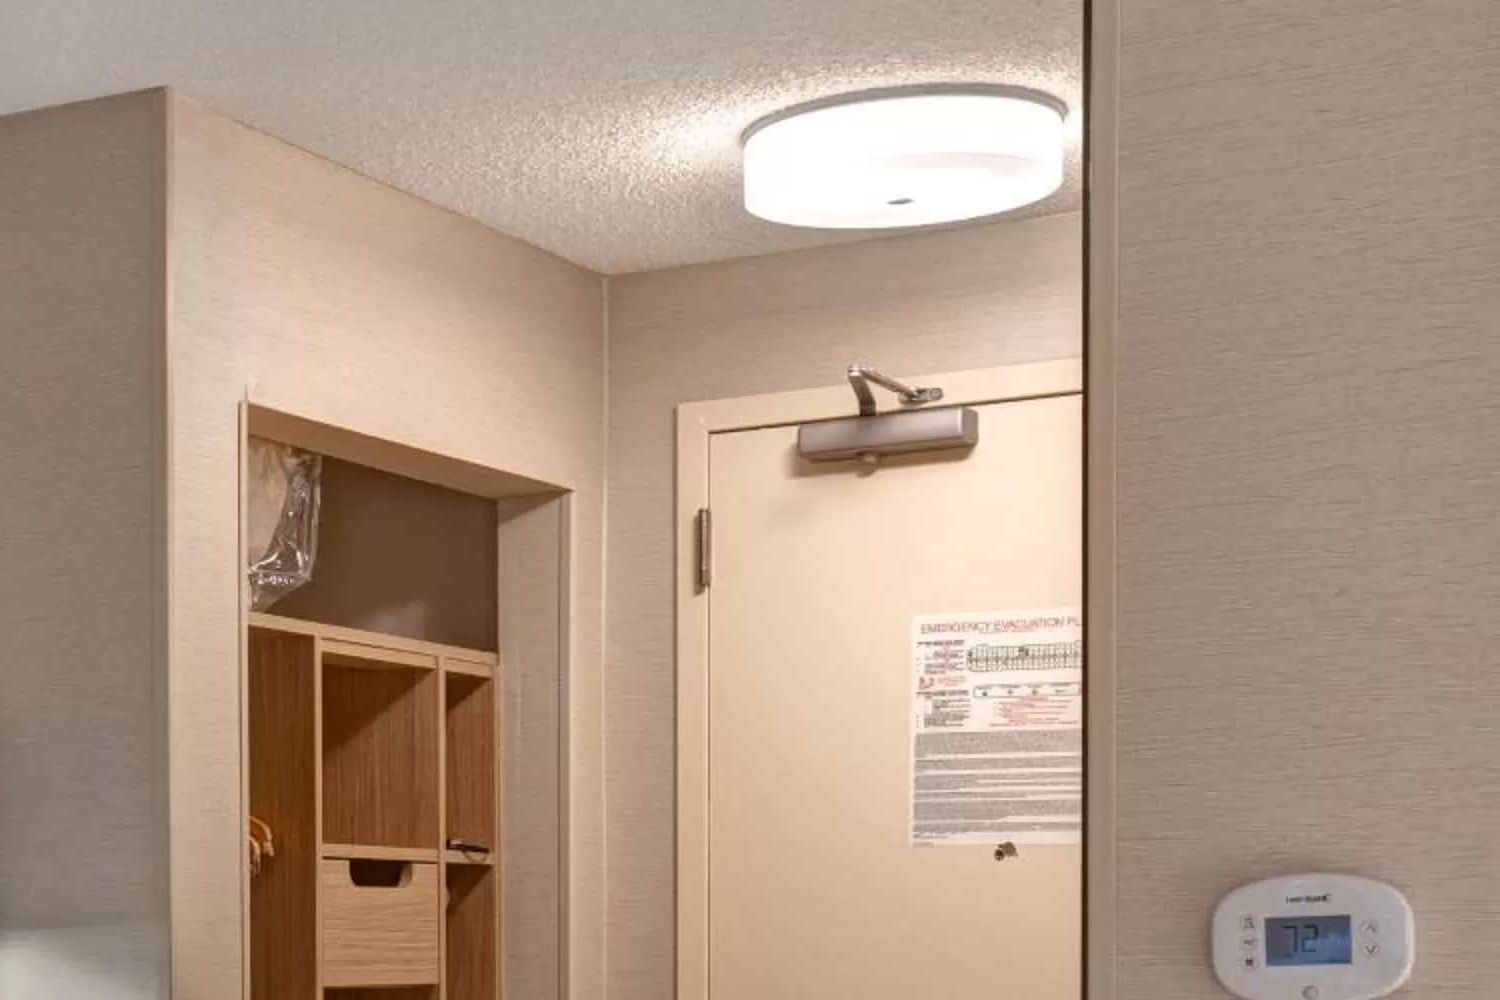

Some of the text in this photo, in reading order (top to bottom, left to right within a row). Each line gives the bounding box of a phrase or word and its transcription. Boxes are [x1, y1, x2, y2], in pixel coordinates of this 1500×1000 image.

[920, 621, 991, 635] EMERGENCY
[994, 616, 1064, 632] EVACUATION
[1283, 924, 1320, 954] 72
